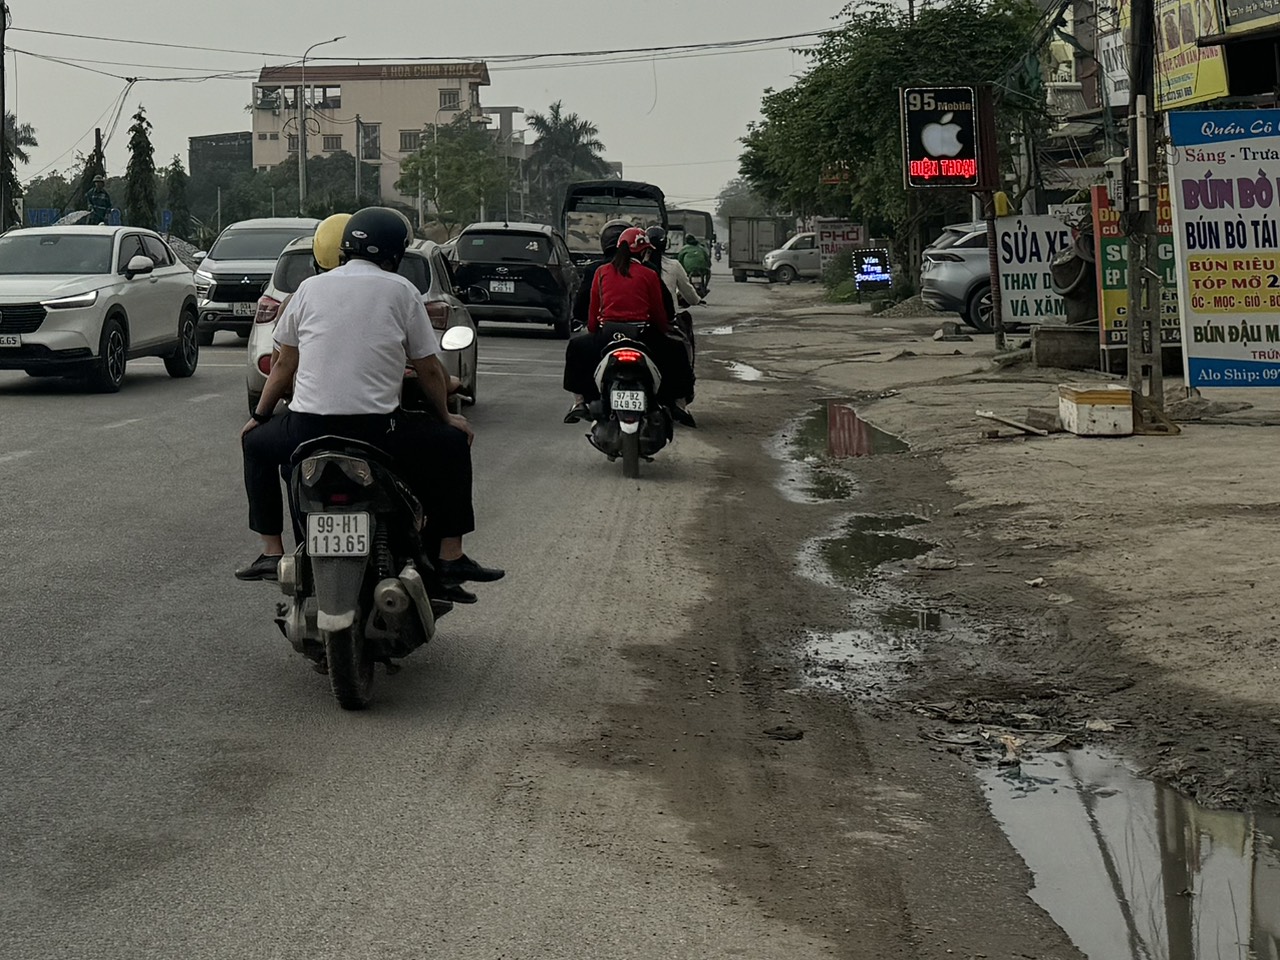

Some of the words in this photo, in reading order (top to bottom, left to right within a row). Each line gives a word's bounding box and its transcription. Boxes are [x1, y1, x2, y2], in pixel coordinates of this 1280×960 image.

[909, 93, 935, 111] 95
[938, 102, 971, 111] Mobile
[1201, 121, 1245, 137] Quán
[1250, 120, 1272, 134] Cô
[1184, 148, 1226, 165] Sáng
[1240, 147, 1280, 161] Trưa
[1181, 169, 1235, 210] BÚN
[1237, 167, 1273, 209] BÒ
[820, 228, 859, 241] PHỞ
[1185, 215, 1221, 250] BÚN
[1224, 213, 1247, 249] BÒ
[1250, 213, 1278, 249] TÁI
[1001, 220, 1042, 264] SỬA
[1045, 231, 1069, 262] XE
[1189, 257, 1228, 272] BÚN
[1233, 256, 1275, 271] RIÊU
[1002, 273, 1037, 290] THAY
[1192, 275, 1227, 289] TÓP
[1232, 274, 1262, 289] MỠ
[1011, 295, 1029, 316] VÁ
[1035, 295, 1067, 316] XĂM
[1192, 292, 1205, 308] ỐC
[1213, 296, 1235, 311] MỌC
[1193, 320, 1225, 343] BÚN
[1228, 319, 1262, 347] ĐẬU
[1198, 369, 1221, 380] Alo
[1224, 368, 1260, 382] Ship:
[317, 515, 358, 534] 99-H1
[312, 535, 366, 553] 113.65
